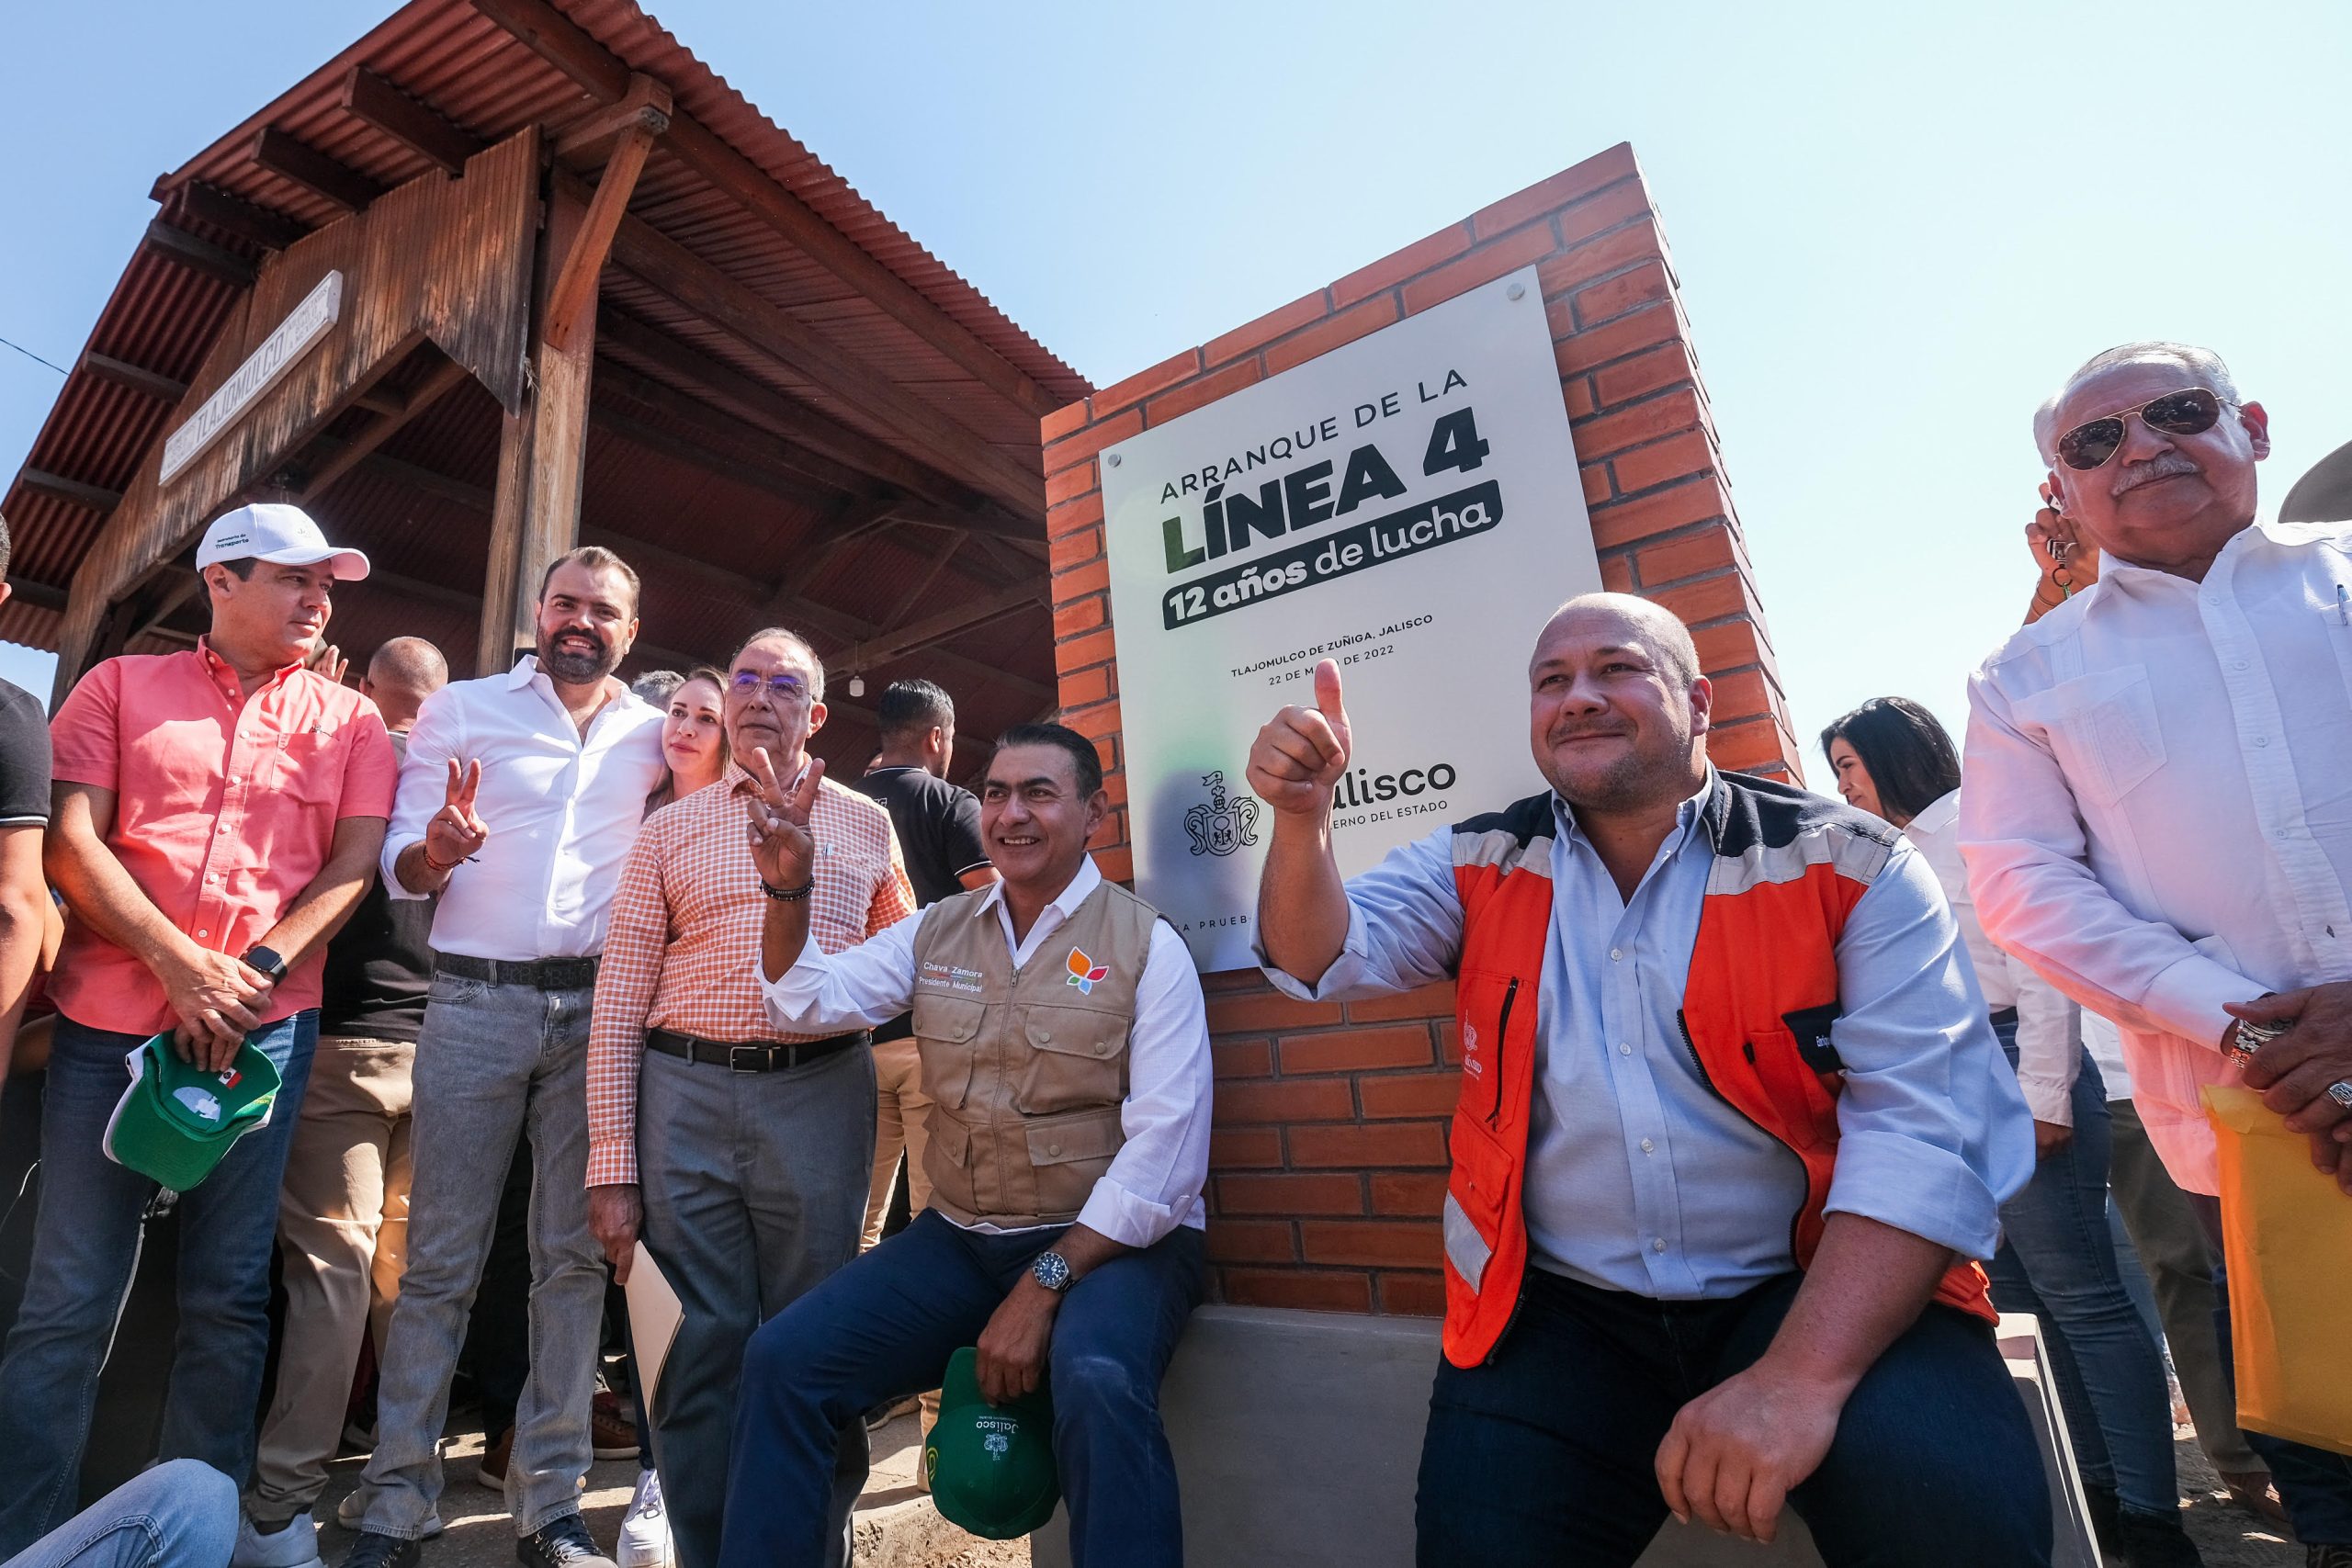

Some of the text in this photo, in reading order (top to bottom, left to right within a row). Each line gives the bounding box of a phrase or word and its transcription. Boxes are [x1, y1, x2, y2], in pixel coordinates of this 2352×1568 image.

[197, 332, 285, 443] TLAJOMULCO
[1159, 369, 1468, 504] ARRANQUE DE LA
[1162, 406, 1490, 574] LÍNEA 4
[1169, 502, 1492, 622] 12 años de lucha
[1230, 650, 1306, 678] TLAJOMULCO
[1308, 645, 1325, 657] DE
[1327, 631, 1376, 651] ZUÑIGA,
[1378, 615, 1433, 637] JALISCO
[1268, 645, 1394, 686] 22 DE DE 2022
[1333, 763, 1456, 810] lisco
[1371, 810, 1393, 823] DEL
[1396, 800, 1448, 818] ESTADO
[1199, 915, 1248, 930] PRUEB
[919, 976, 983, 993] Presidente Municipal
[923, 961, 983, 978] Chava Zamora
[976, 1420, 1019, 1434] Jalisco
